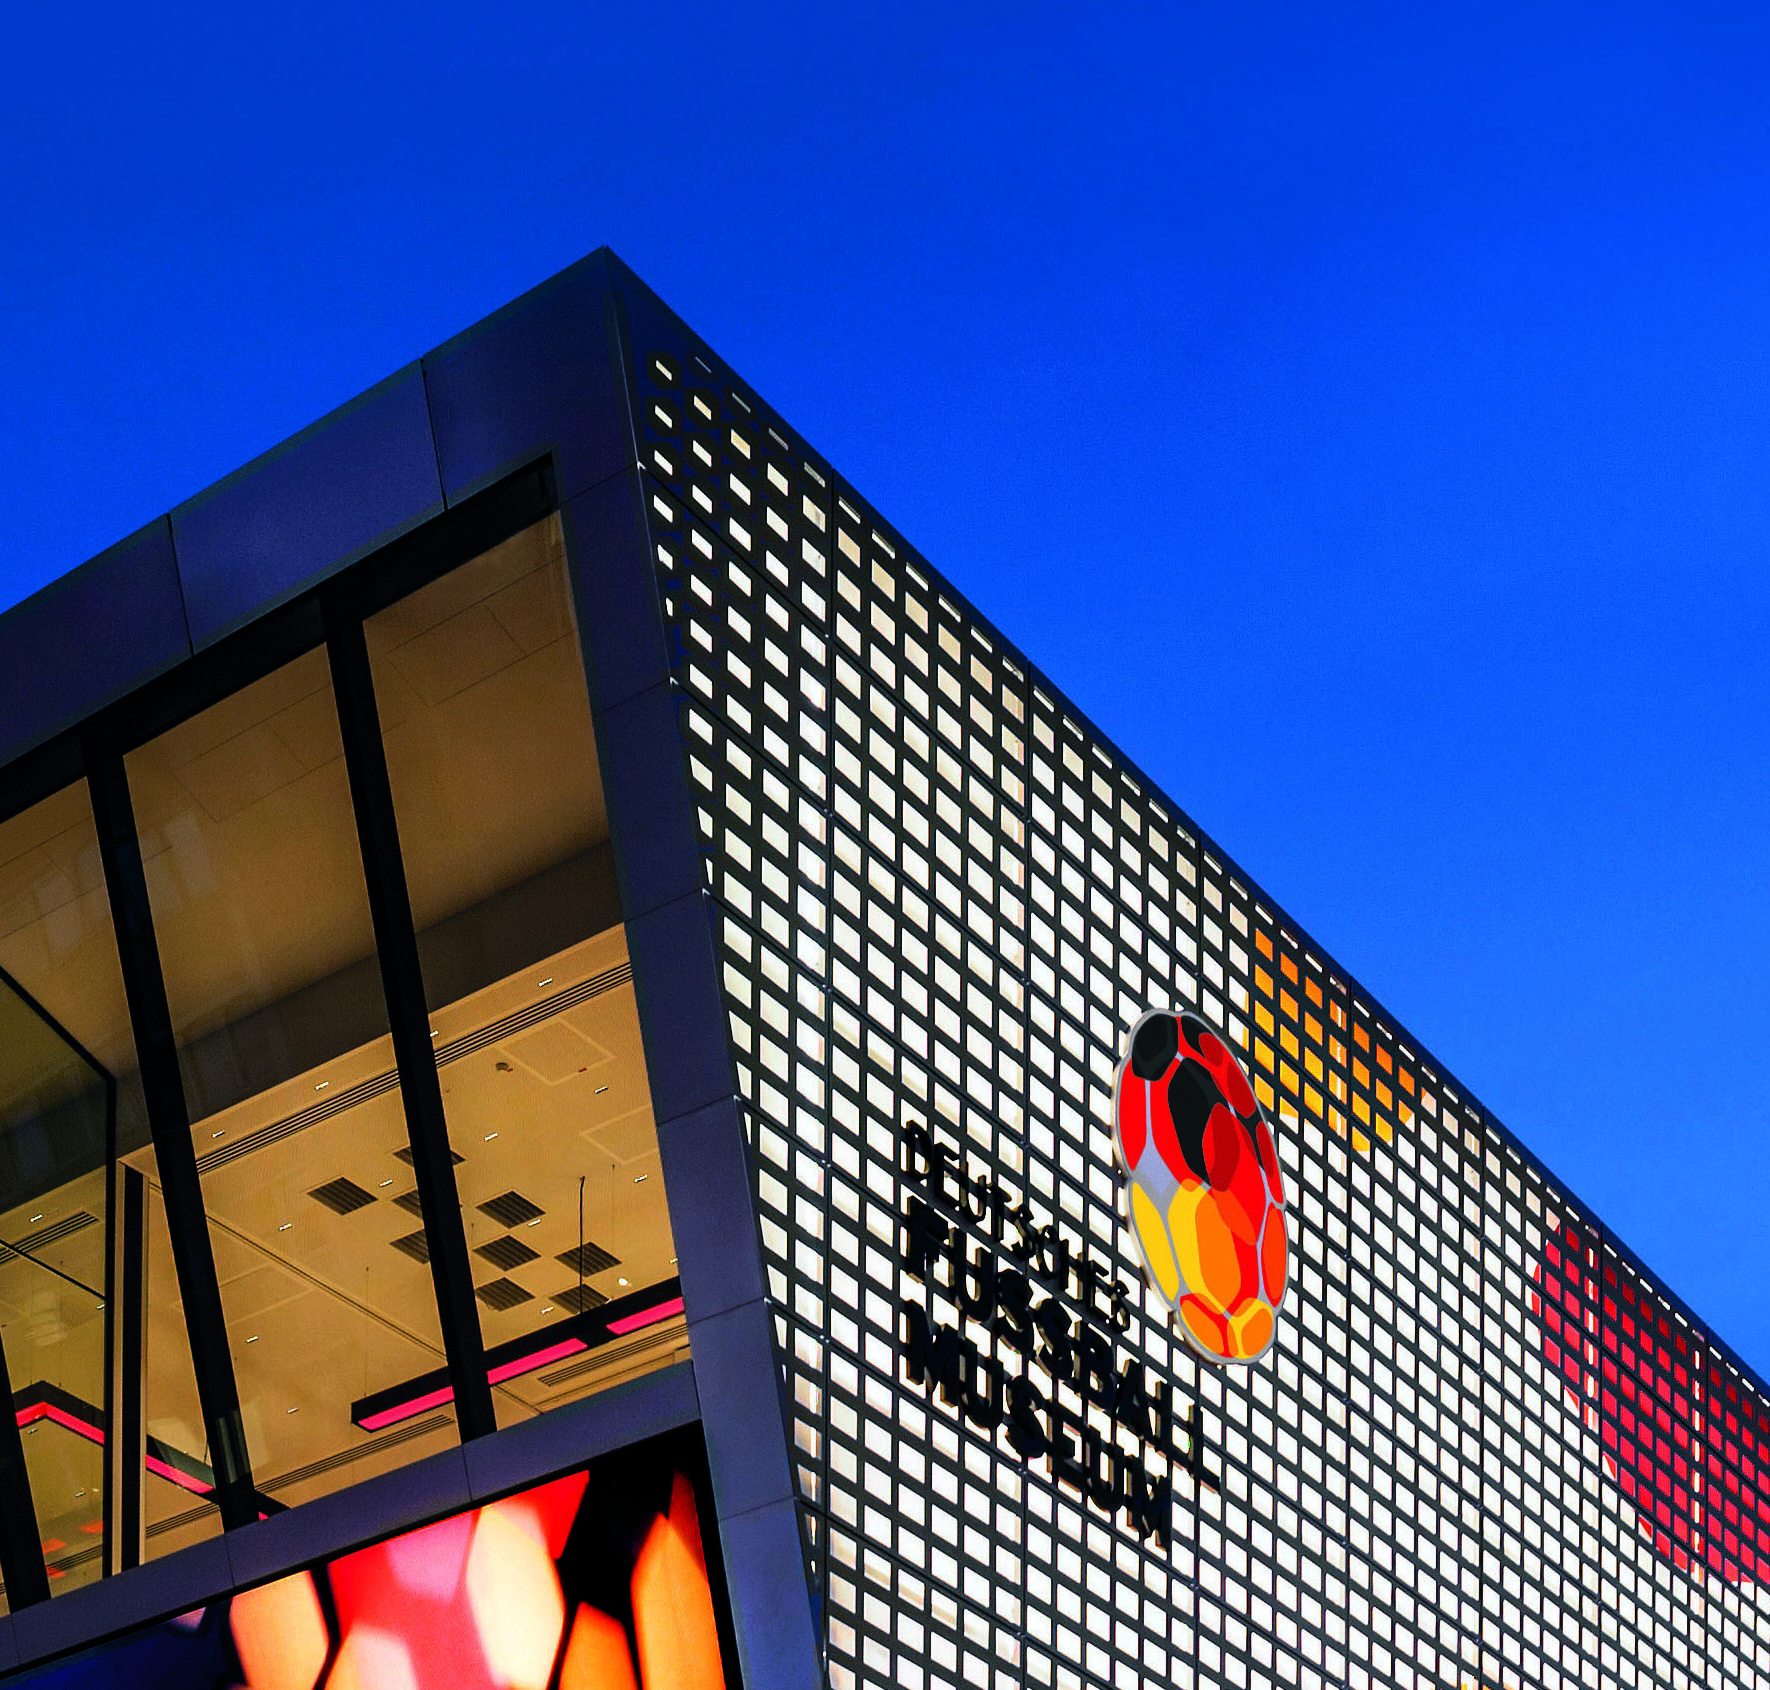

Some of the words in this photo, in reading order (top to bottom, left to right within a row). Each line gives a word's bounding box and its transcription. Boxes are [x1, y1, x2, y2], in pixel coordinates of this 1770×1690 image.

[906, 1120, 1130, 1334] DEUTSCHES
[906, 1196, 1221, 1494] FUSSBALL
[905, 1300, 1174, 1553] MUSEUM
